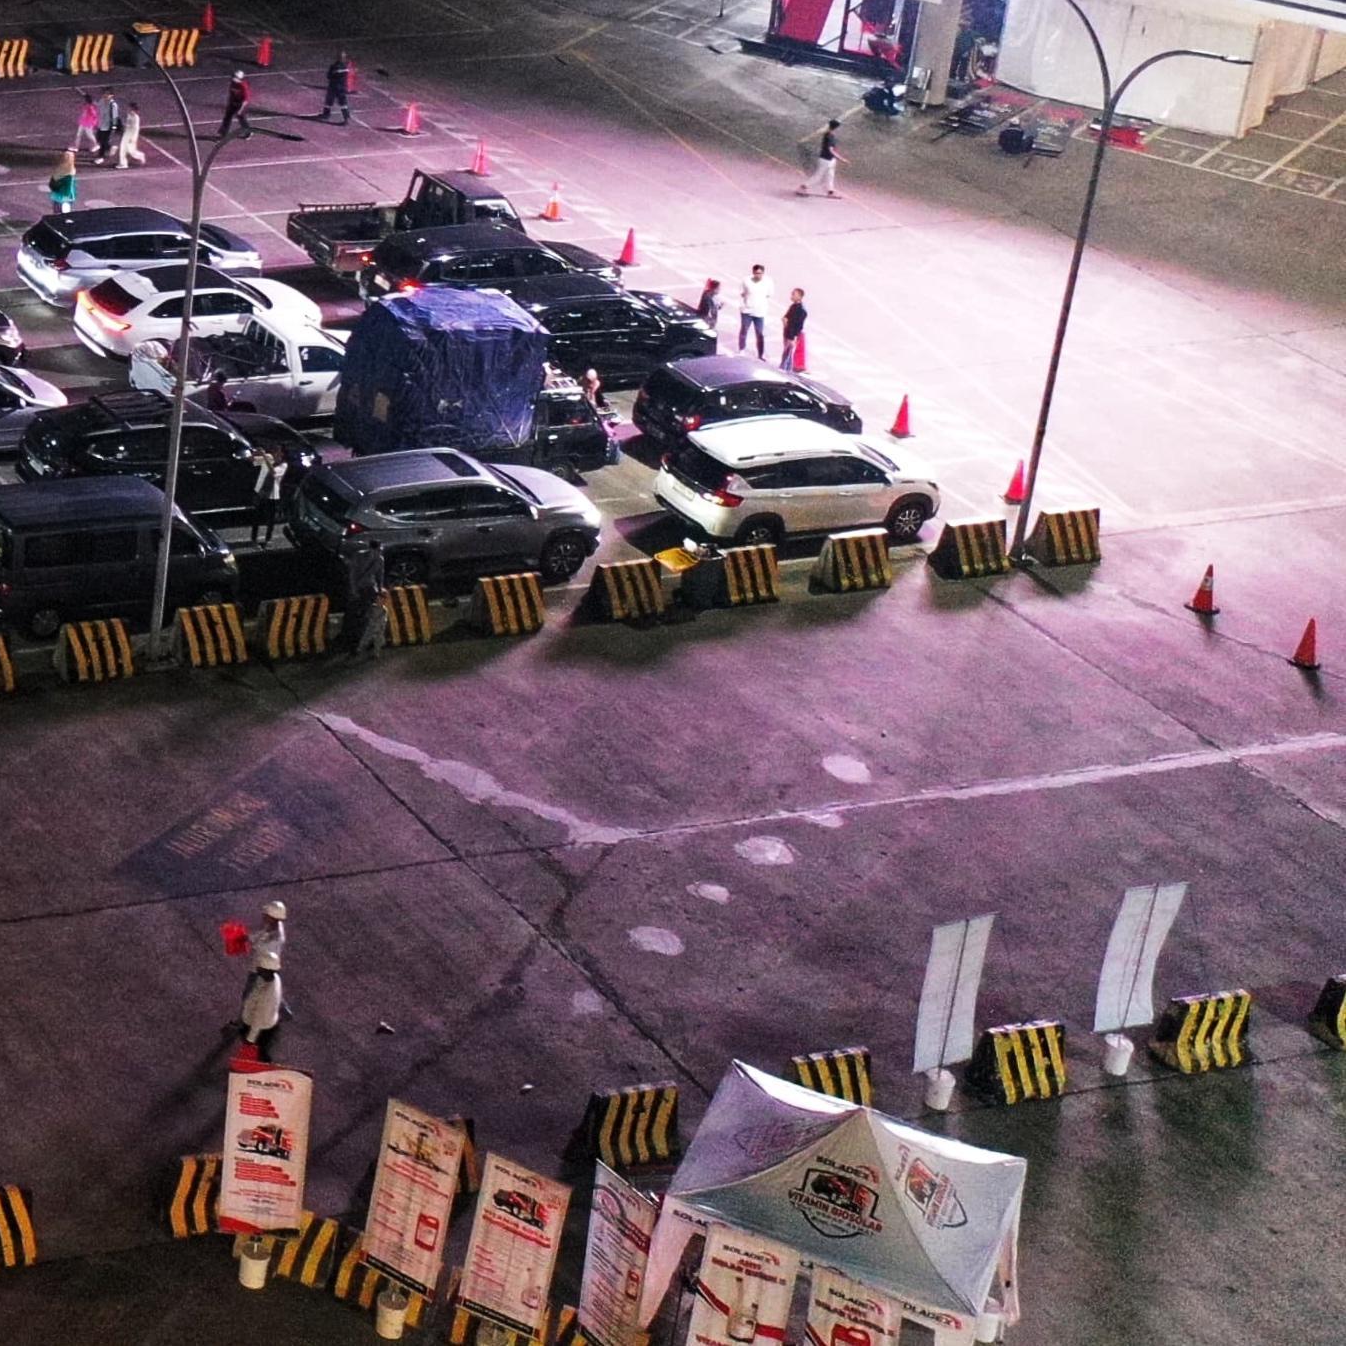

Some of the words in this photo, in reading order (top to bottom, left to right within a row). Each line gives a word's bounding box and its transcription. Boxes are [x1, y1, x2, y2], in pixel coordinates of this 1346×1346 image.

[816, 1156, 870, 1179] SOLADEX
[788, 1188, 830, 1212] VITAMIN
[831, 1205, 884, 1233] BIOSOLAR
[902, 1302, 954, 1325] OLADEX
